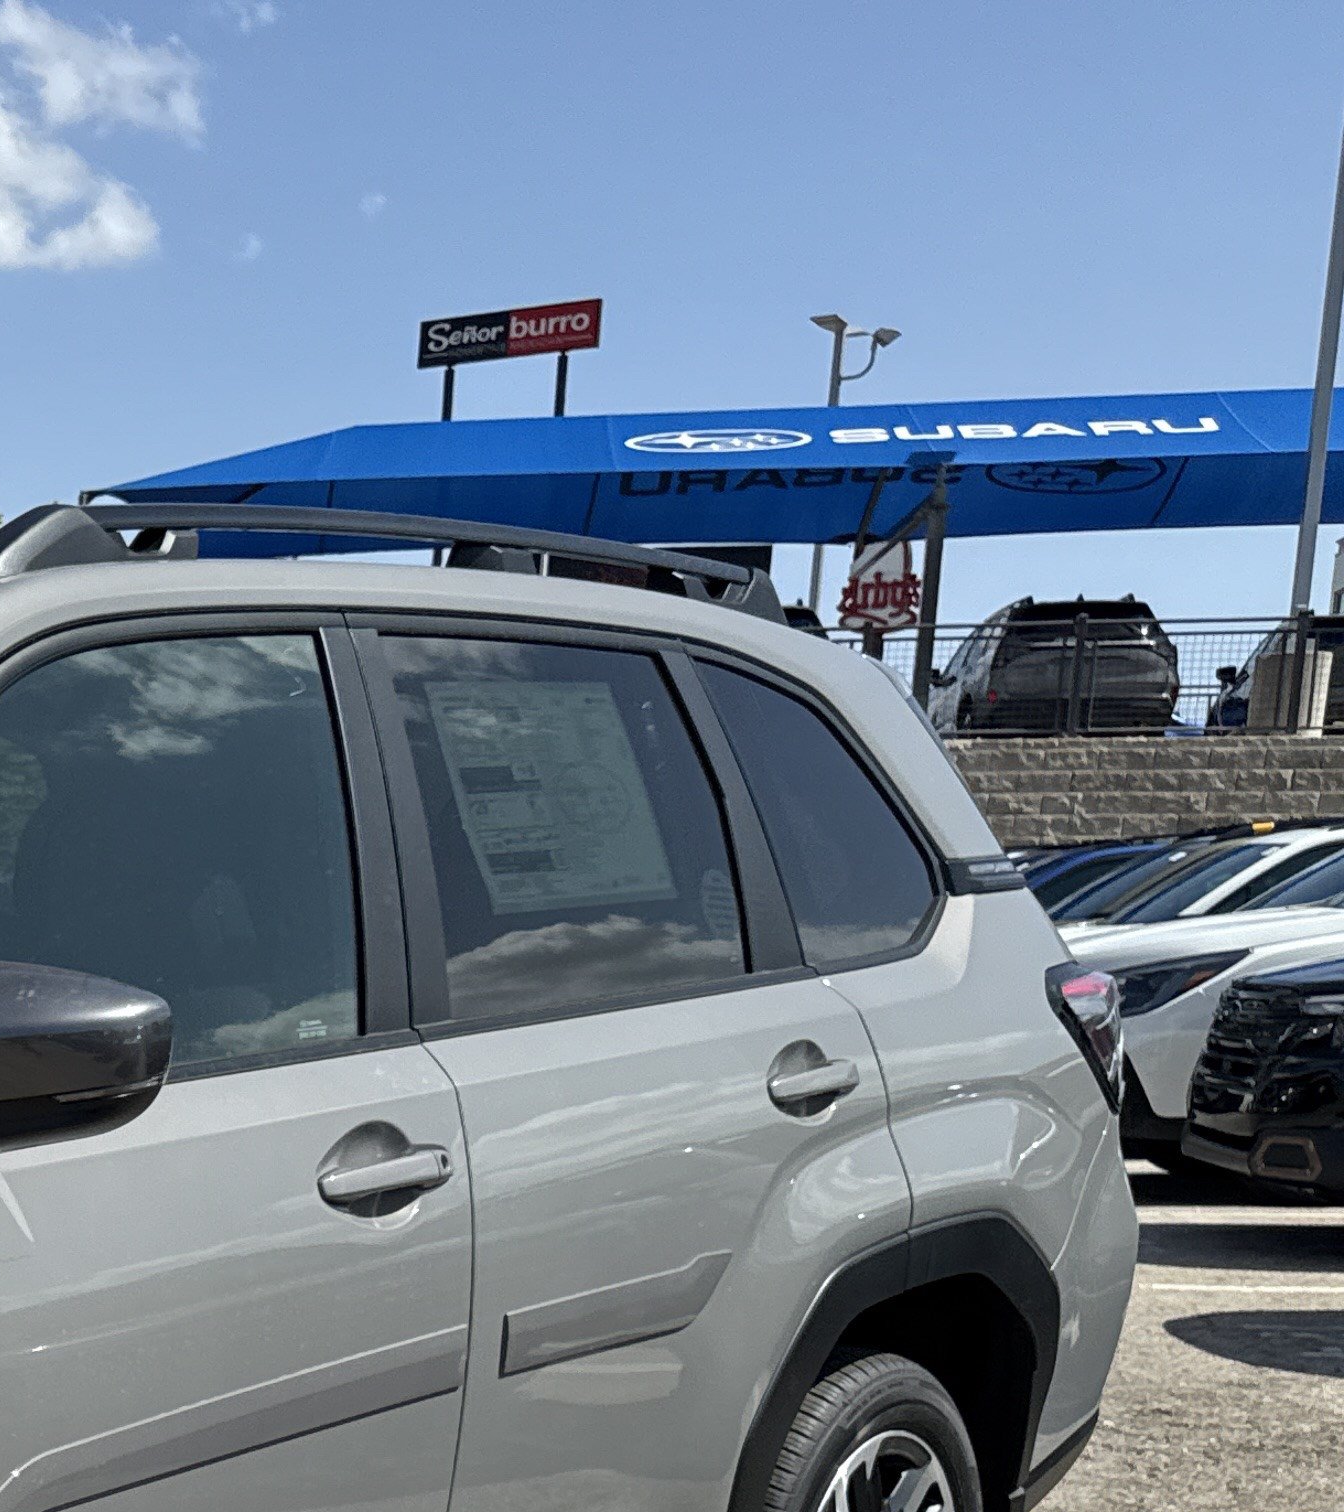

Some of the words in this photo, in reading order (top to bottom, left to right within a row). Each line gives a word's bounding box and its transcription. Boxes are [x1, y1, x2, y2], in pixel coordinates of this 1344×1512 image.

[427, 322, 505, 353] Señor
[510, 312, 590, 339] burro
[829, 418, 1219, 444] SUBARU
